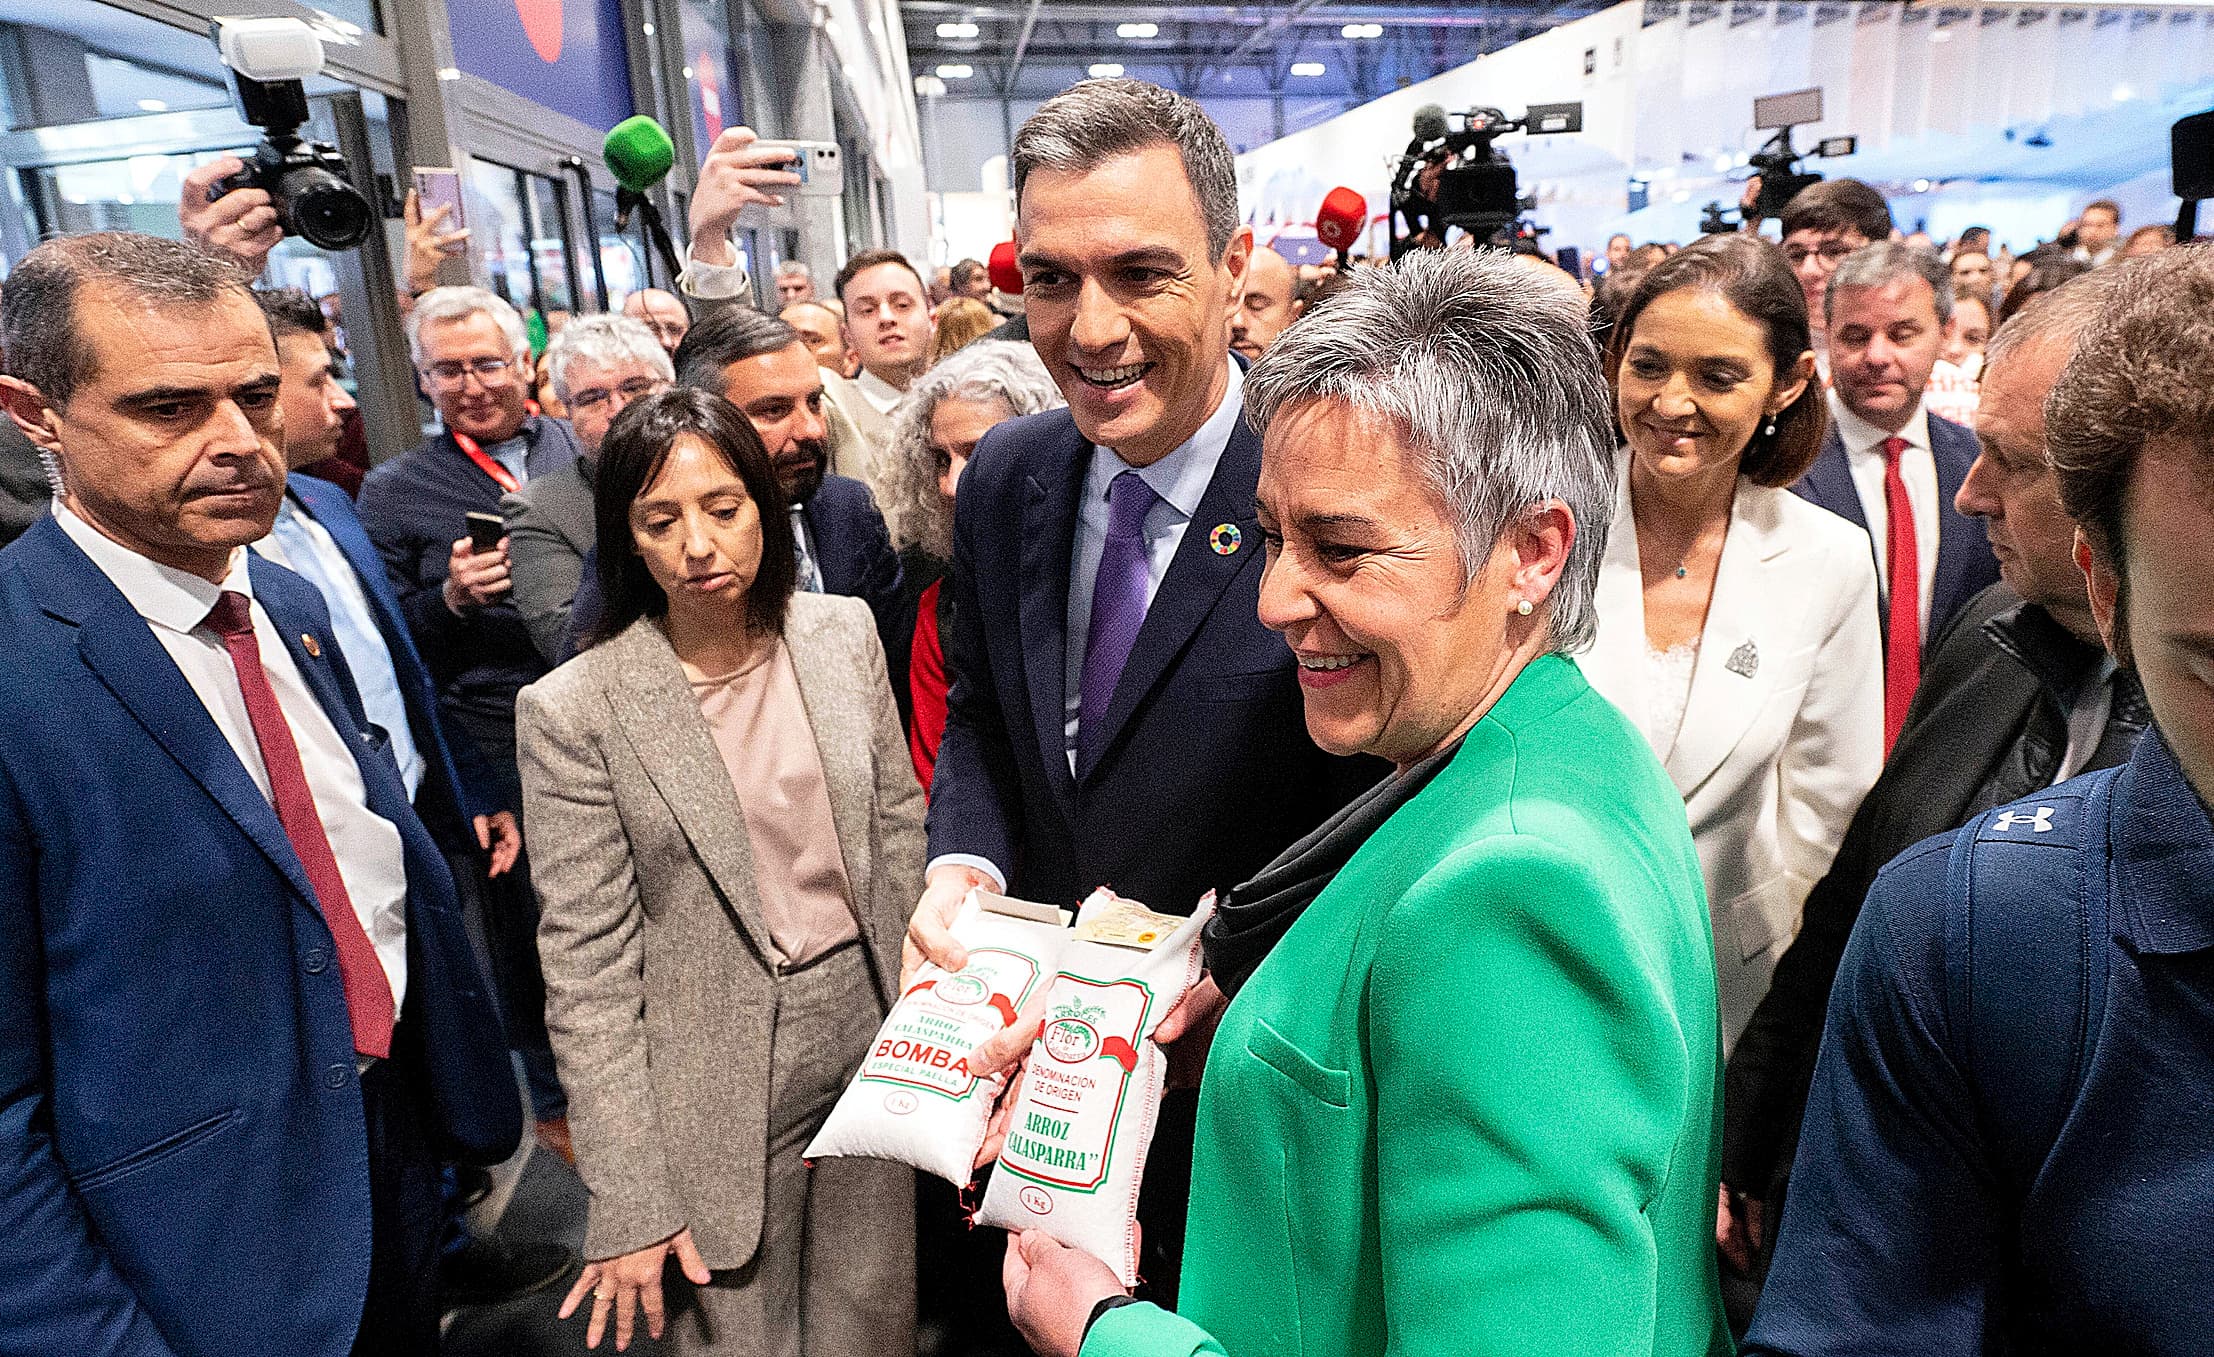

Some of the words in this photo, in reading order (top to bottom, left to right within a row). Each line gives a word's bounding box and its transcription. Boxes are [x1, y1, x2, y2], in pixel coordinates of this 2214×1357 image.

[919, 1015, 961, 1033] ARROZ
[1050, 1025, 1080, 1046] Flor
[875, 1039, 968, 1078] BOMBA
[871, 1061, 914, 1075] ESPECIAL
[919, 1069, 958, 1087] PAELLA
[1034, 1080, 1045, 1093] DE
[1046, 1084, 1082, 1102] ORIGEN
[1024, 1111, 1071, 1141] ARROZ
